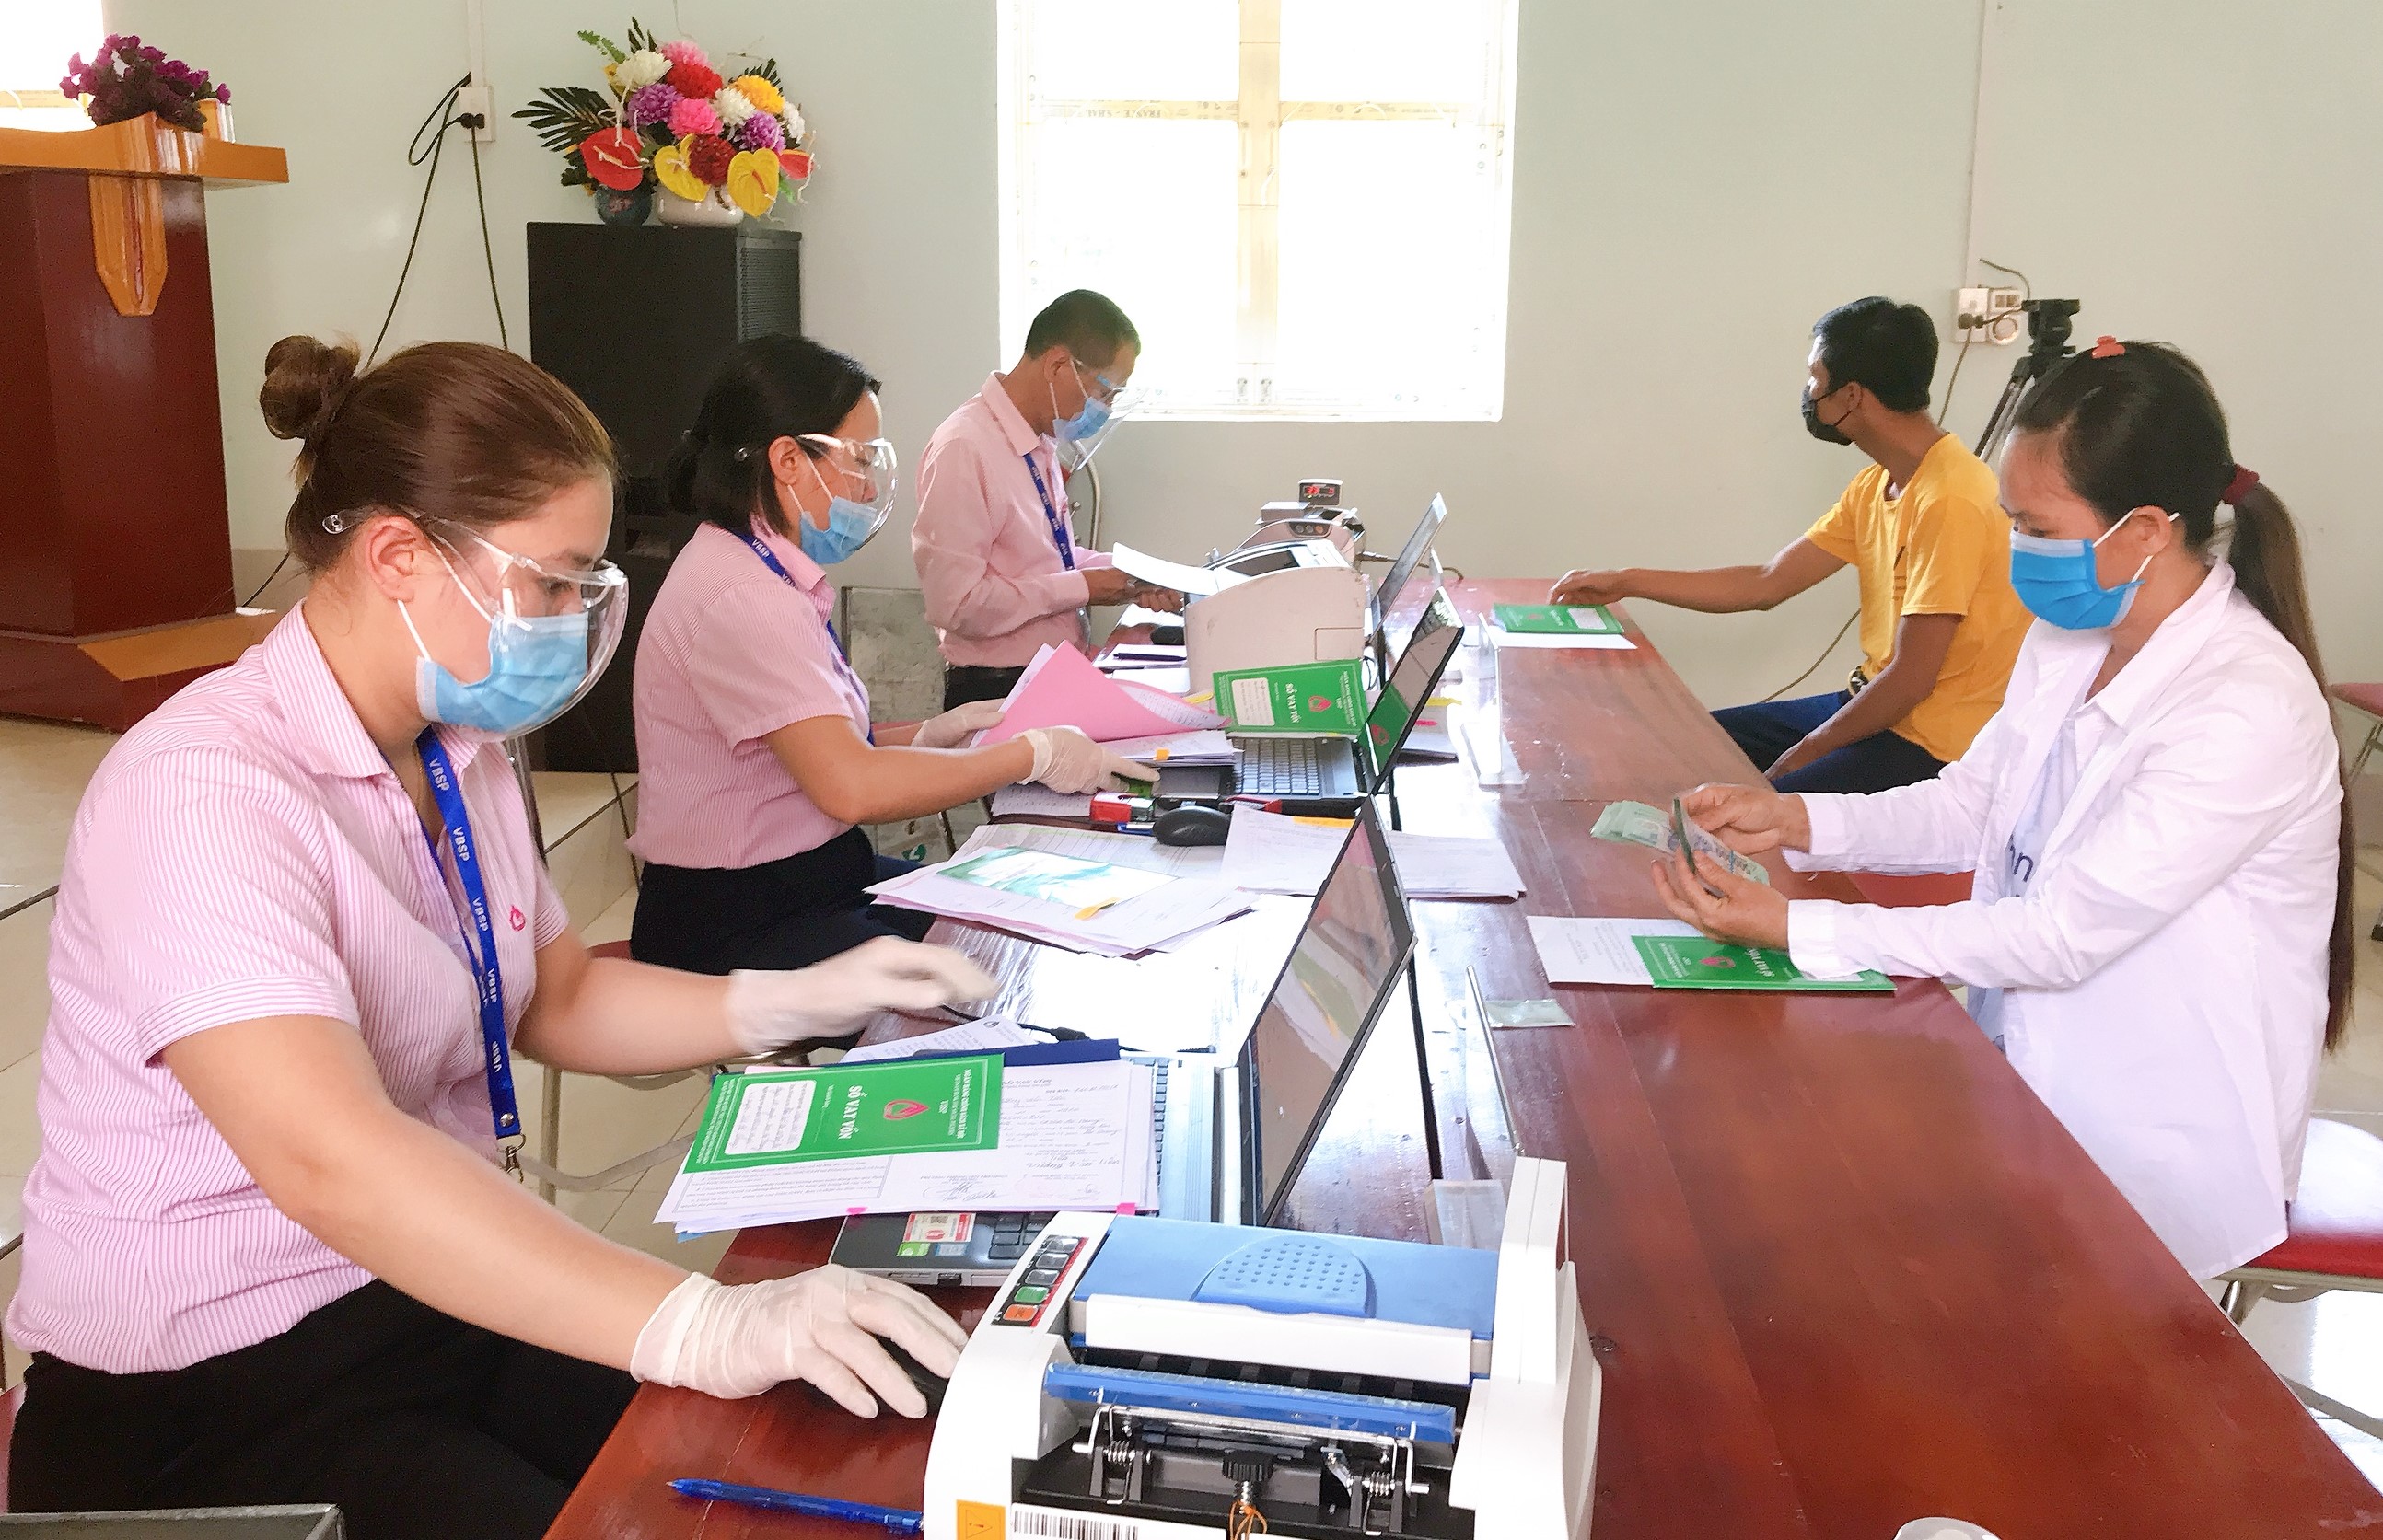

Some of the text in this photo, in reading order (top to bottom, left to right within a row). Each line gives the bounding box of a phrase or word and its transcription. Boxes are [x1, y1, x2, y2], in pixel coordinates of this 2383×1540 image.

[429, 758, 450, 791] VBSP
[453, 826, 470, 862] VBSP
[472, 897, 489, 932] VBSP
[488, 968, 497, 1003] VBSP
[838, 1085, 867, 1140] SỔ VAY VỐN
